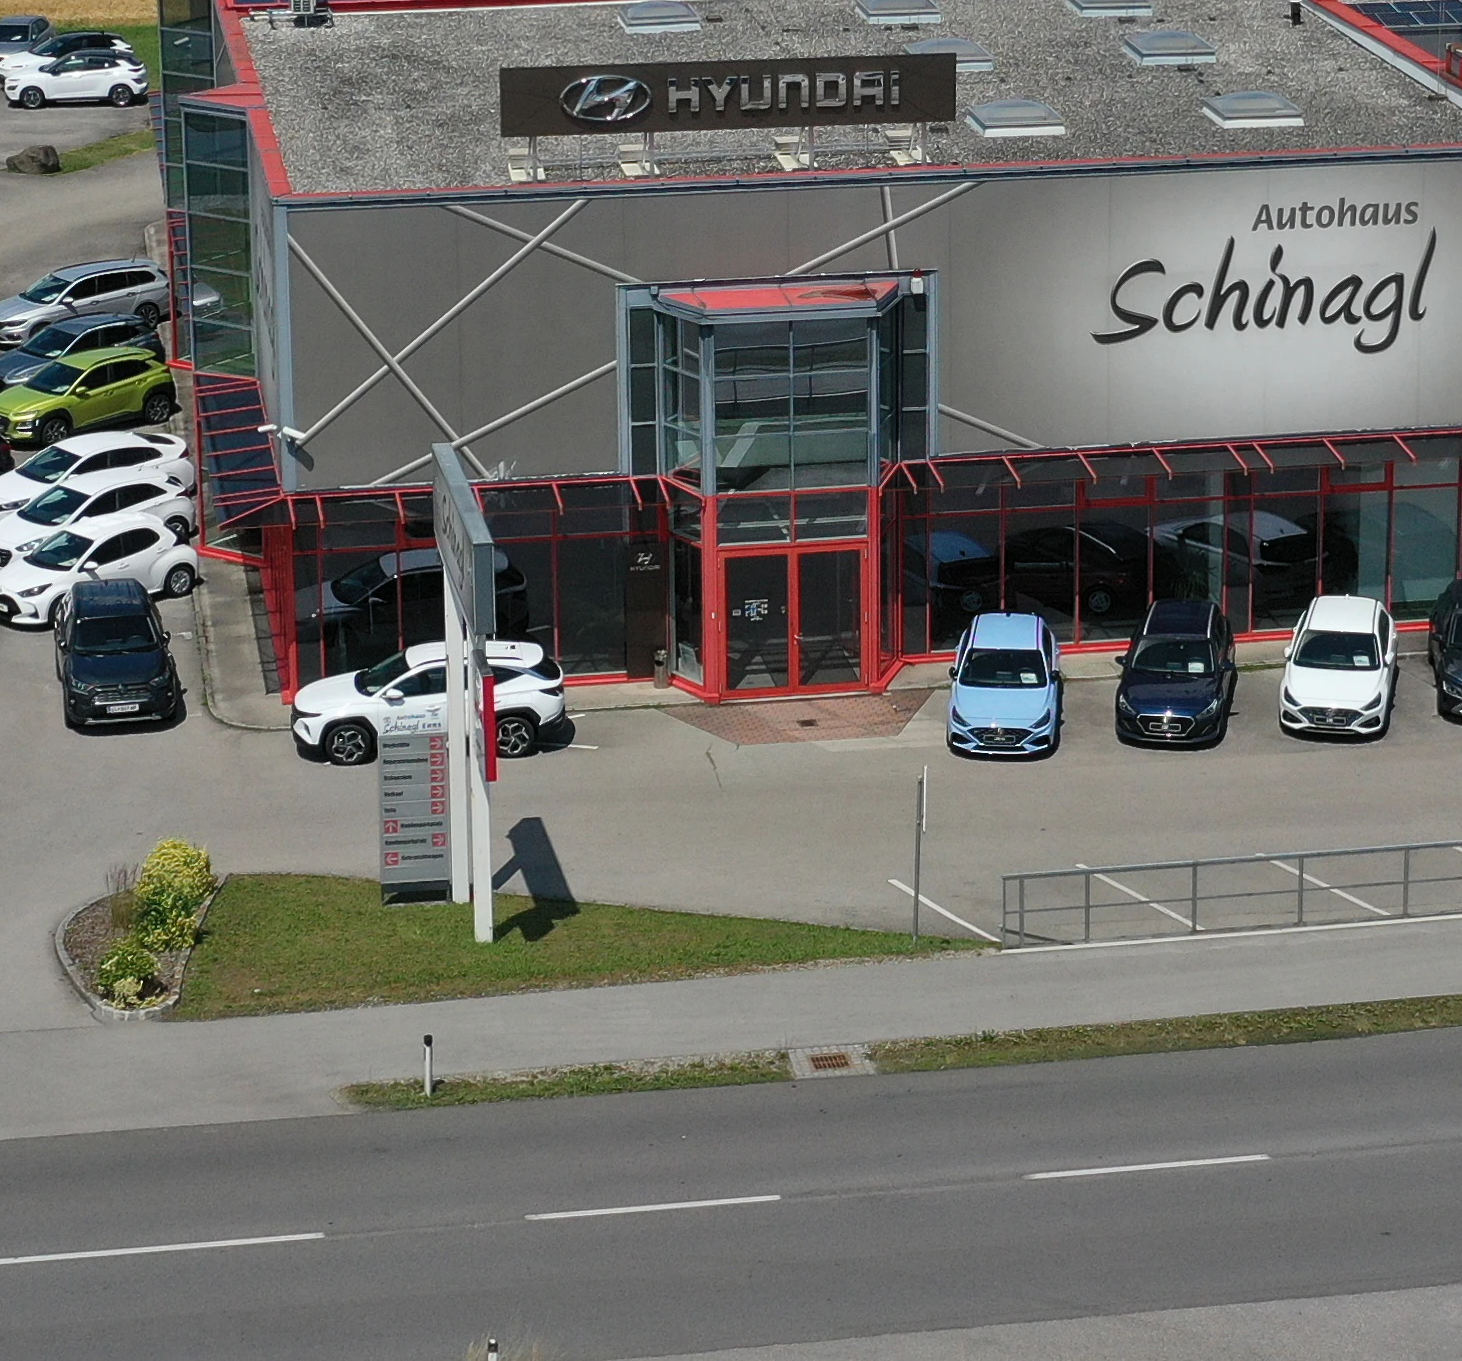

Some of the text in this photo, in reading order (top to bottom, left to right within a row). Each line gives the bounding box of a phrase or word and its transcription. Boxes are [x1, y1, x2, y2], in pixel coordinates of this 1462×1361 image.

[667, 70, 900, 114] HYUNDAI
[1251, 197, 1420, 232] Autohaus
[1090, 226, 1436, 354] Schinagl
